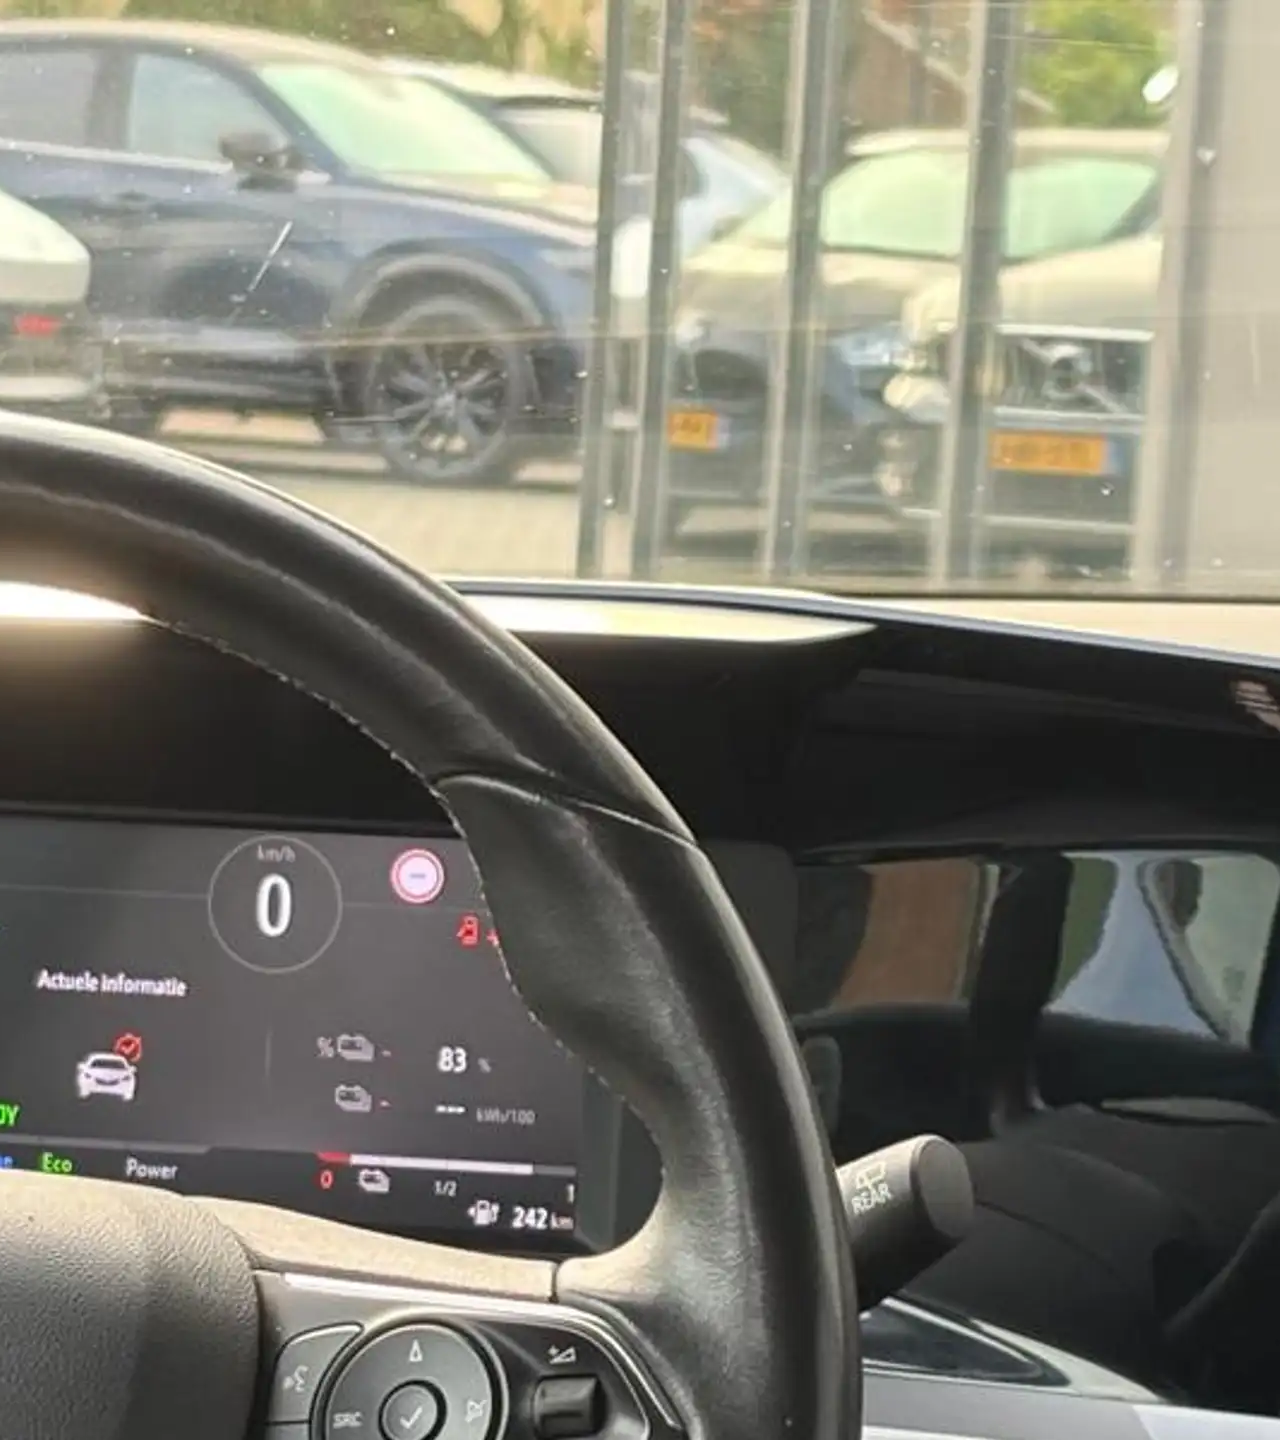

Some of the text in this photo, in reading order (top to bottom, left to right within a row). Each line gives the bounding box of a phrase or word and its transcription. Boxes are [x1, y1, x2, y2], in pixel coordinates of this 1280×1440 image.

[257, 845, 296, 862] km/h
[256, 873, 291, 937] 0
[37, 969, 98, 992] Actuele
[437, 1047, 468, 1073] 83
[42, 1151, 73, 1173] Eco
[125, 1157, 178, 1180] Power
[320, 1171, 333, 1190] 0
[434, 1180, 457, 1197] 1/2
[852, 1183, 892, 1216] REAR
[512, 1206, 574, 1230] 242 km
[332, 1412, 363, 1428] SRC
